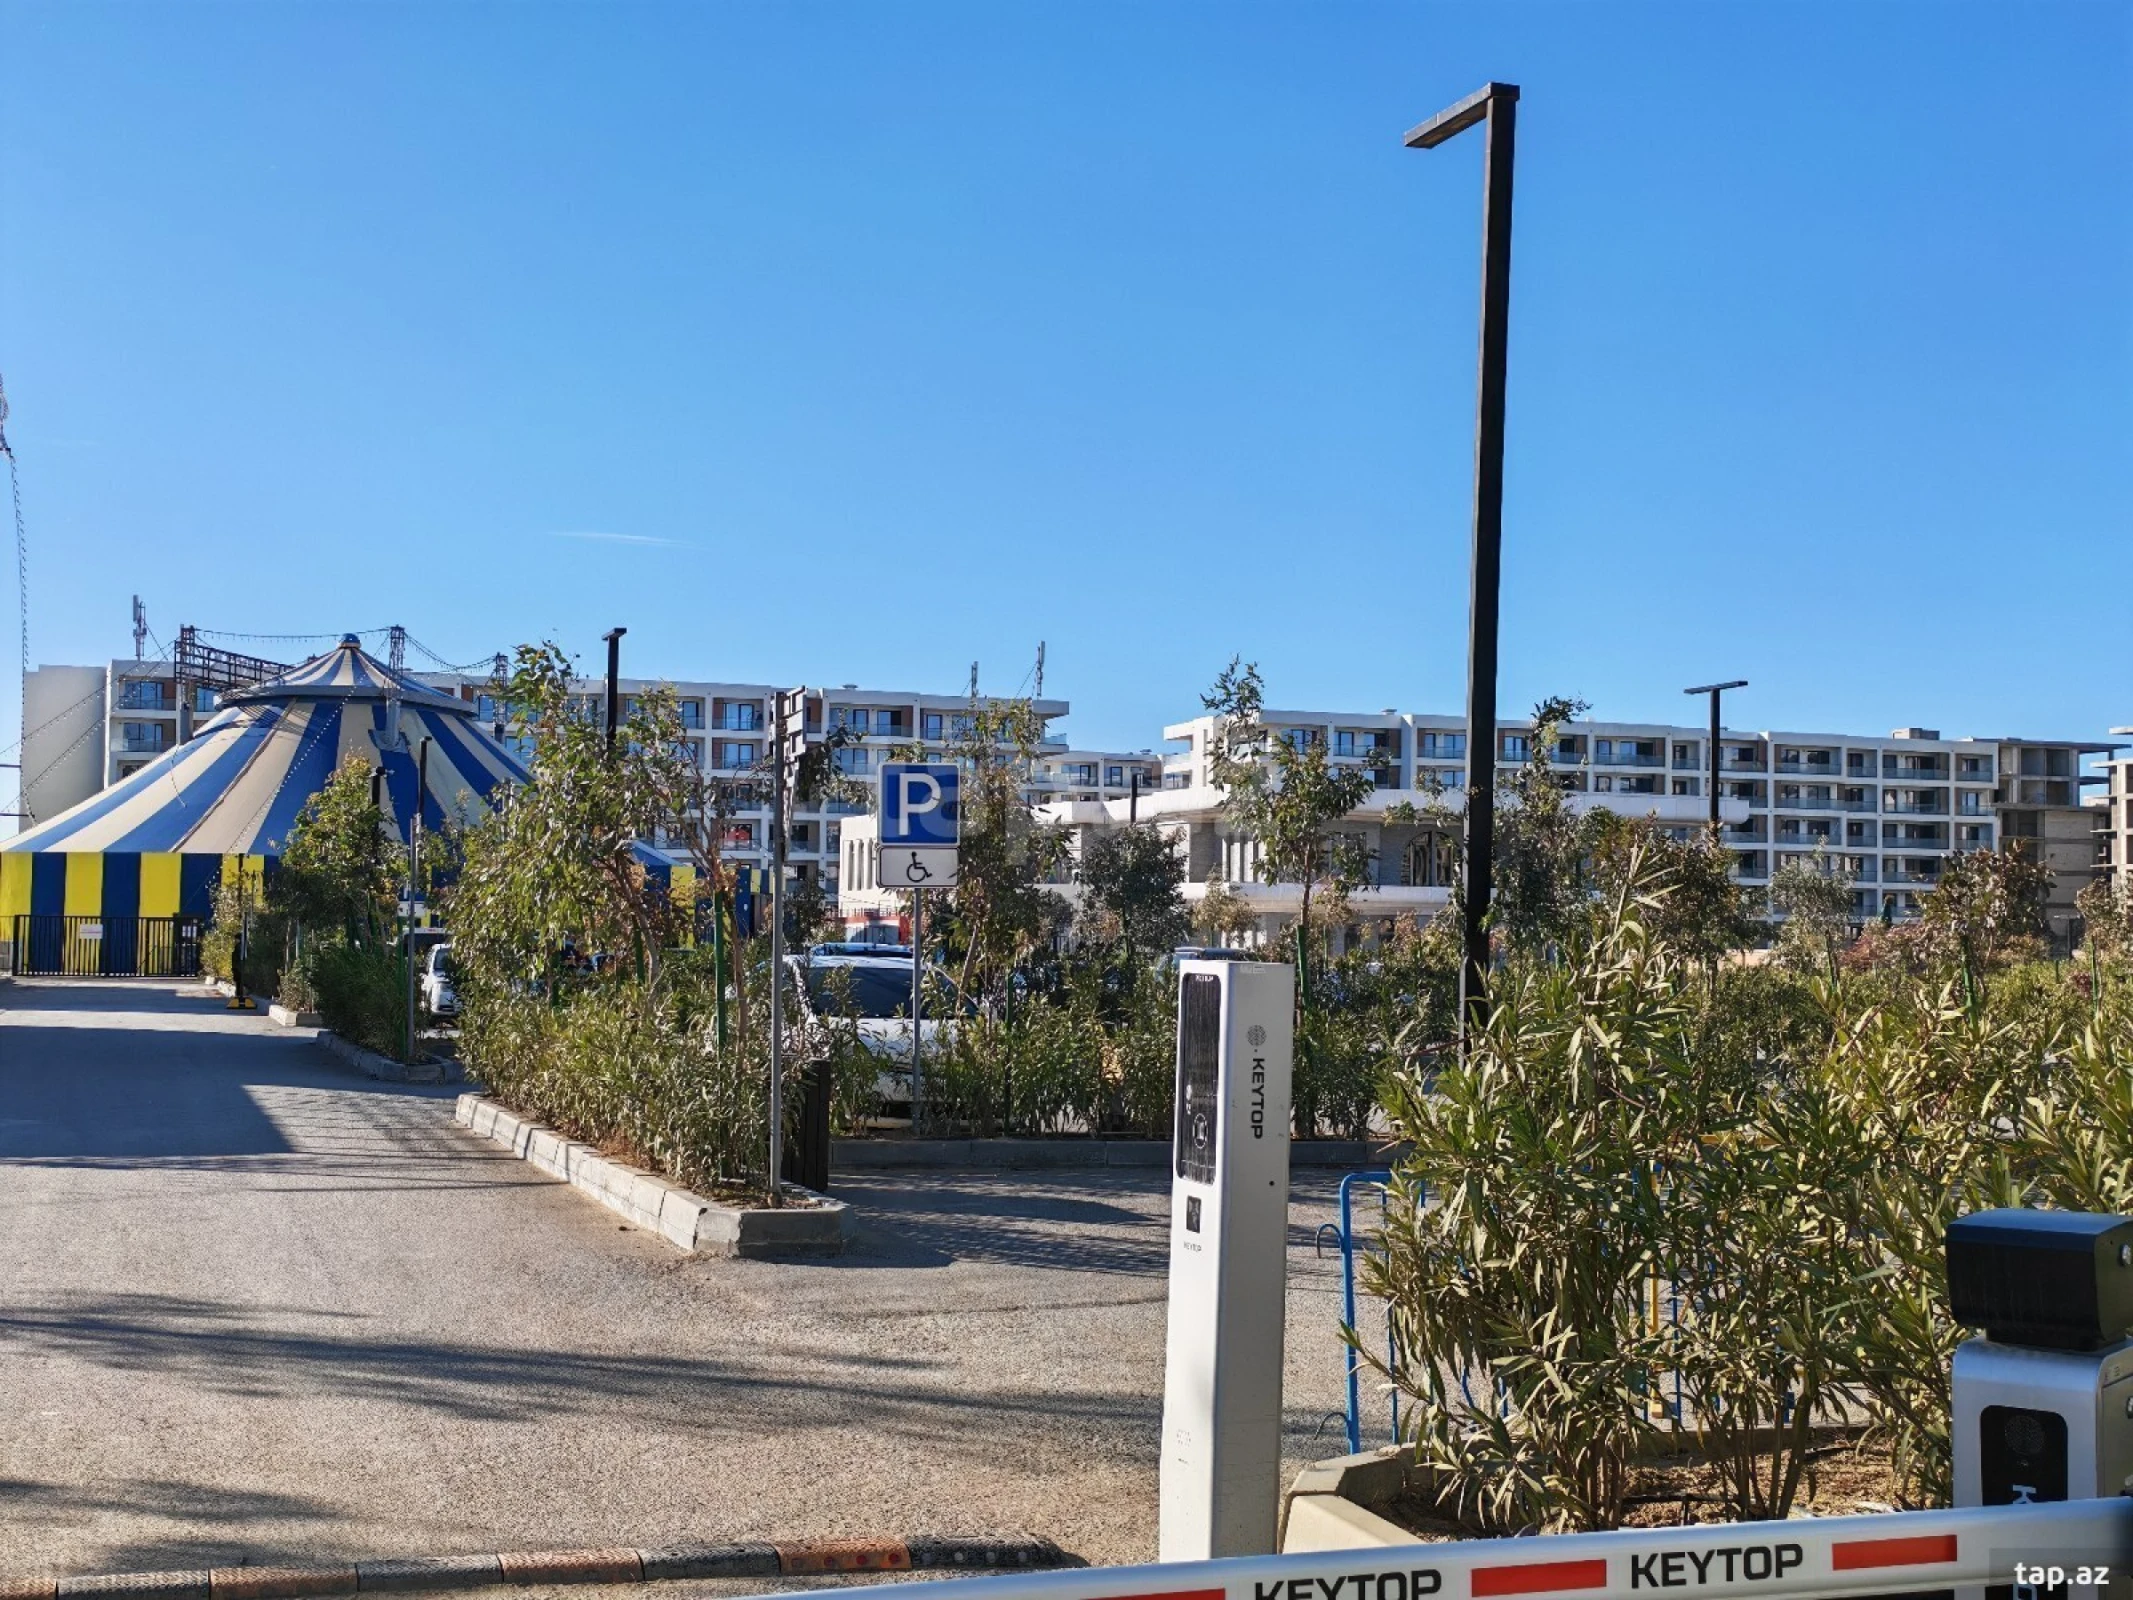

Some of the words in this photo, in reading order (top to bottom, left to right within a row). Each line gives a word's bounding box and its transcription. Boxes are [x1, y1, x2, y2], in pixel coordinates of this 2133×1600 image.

[899, 772, 941, 835] P
[1250, 1058, 1265, 1139] KEYTOP
[1631, 1544, 1803, 1589] KEYTOP
